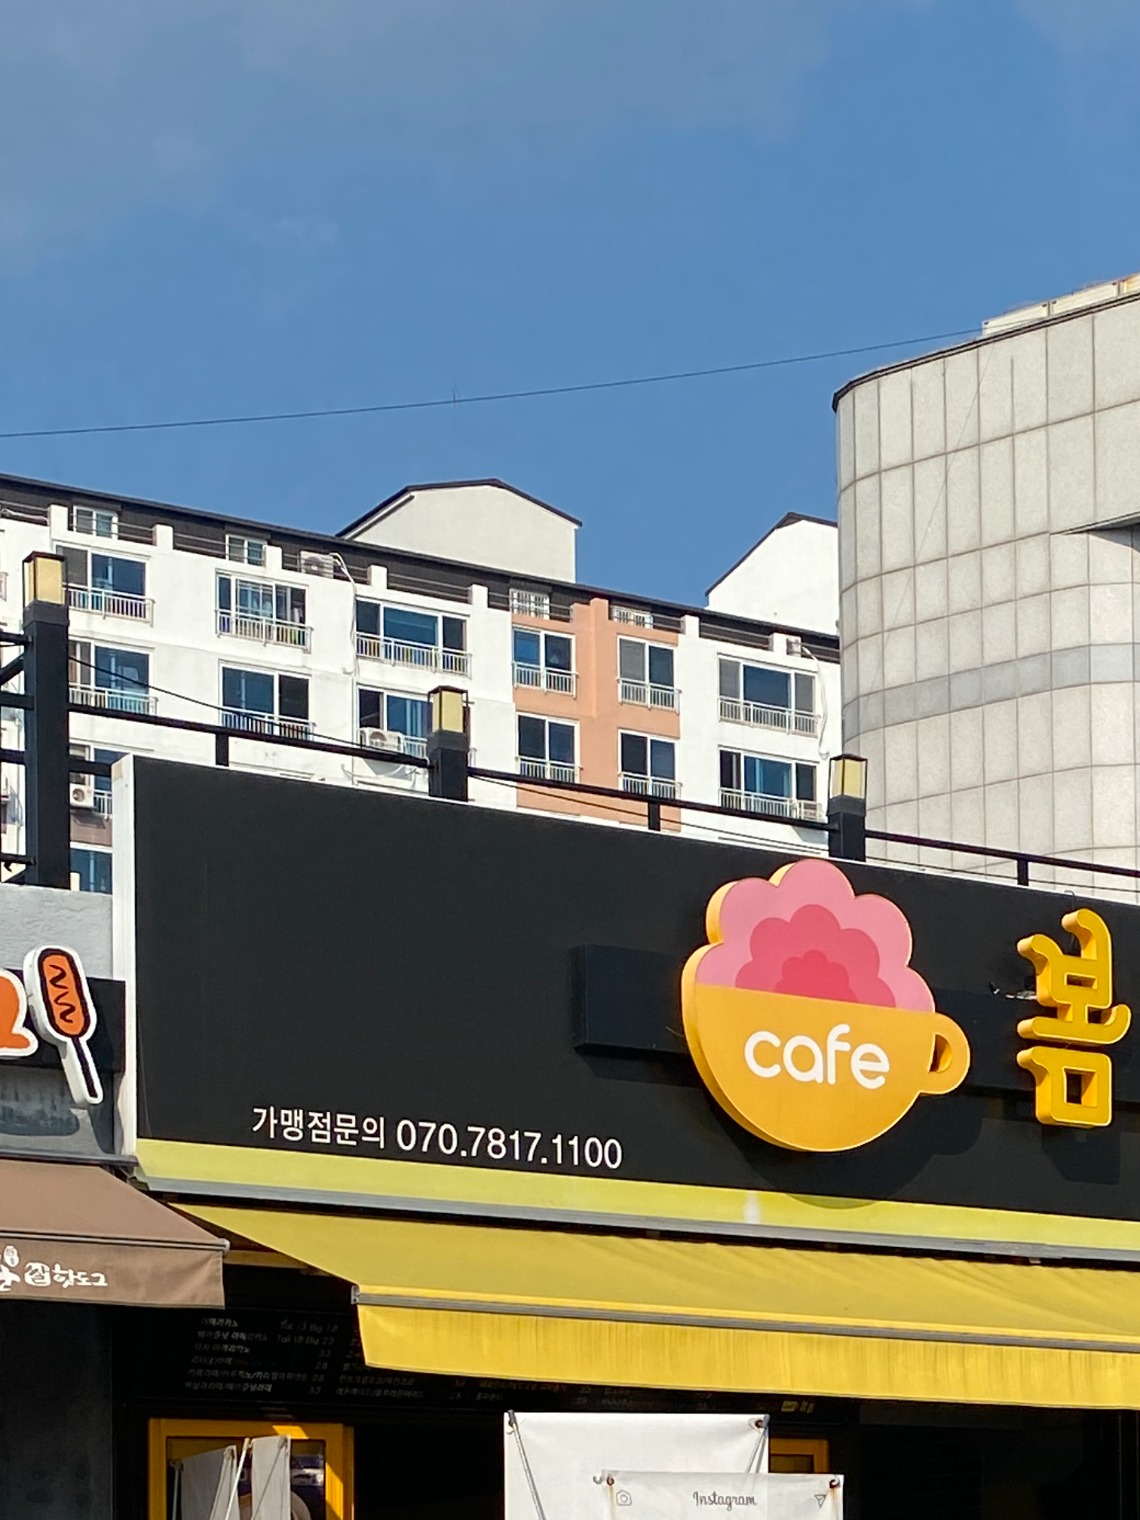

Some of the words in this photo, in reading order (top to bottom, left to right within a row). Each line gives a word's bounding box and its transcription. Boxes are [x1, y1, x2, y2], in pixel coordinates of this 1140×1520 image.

[743, 1022, 890, 1089] cafe
[251, 1105, 386, 1150] 가맹점문의
[397, 1119, 623, 1169] 070.7817.1100
[692, 1491, 758, 1512] Instagram
